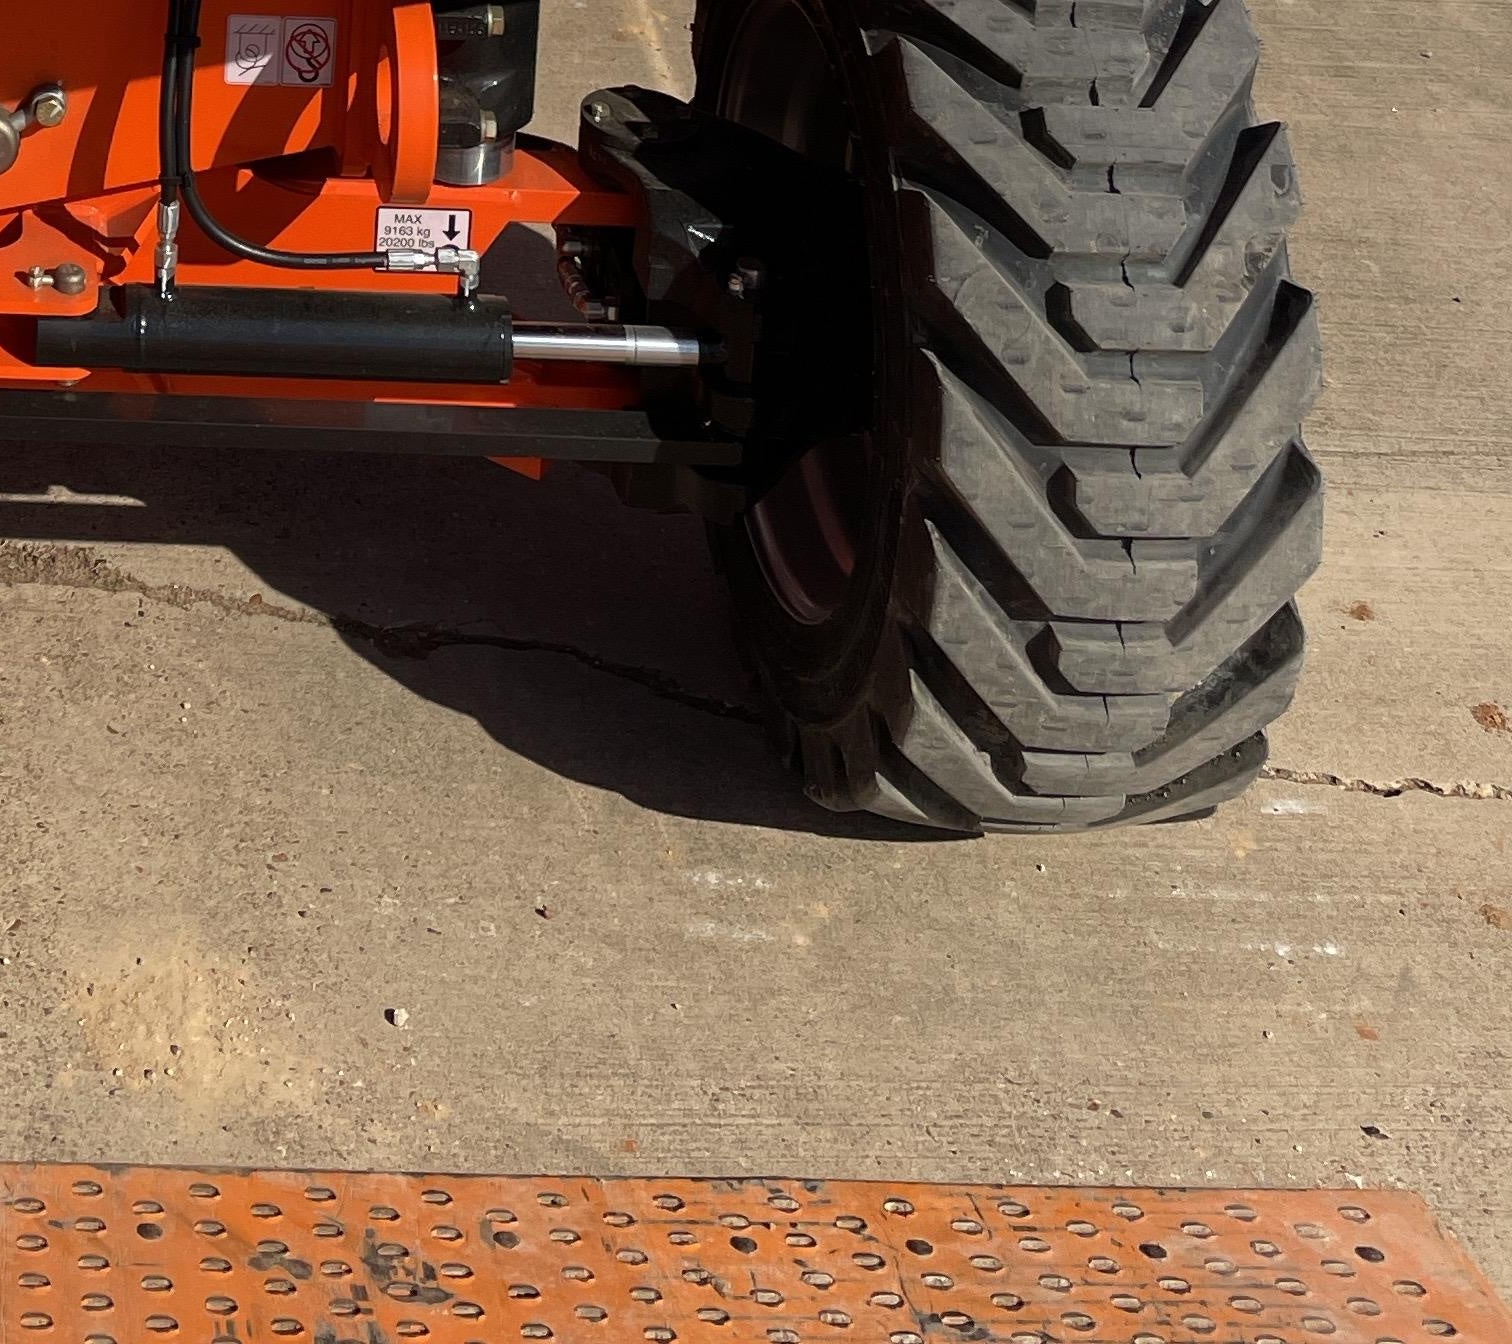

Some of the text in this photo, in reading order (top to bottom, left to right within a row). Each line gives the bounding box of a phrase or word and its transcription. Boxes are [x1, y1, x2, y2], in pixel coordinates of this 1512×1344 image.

[394, 214, 422, 224] MAX
[384, 226, 430, 238] 9163 kg
[379, 237, 435, 248] 20200 lbs
